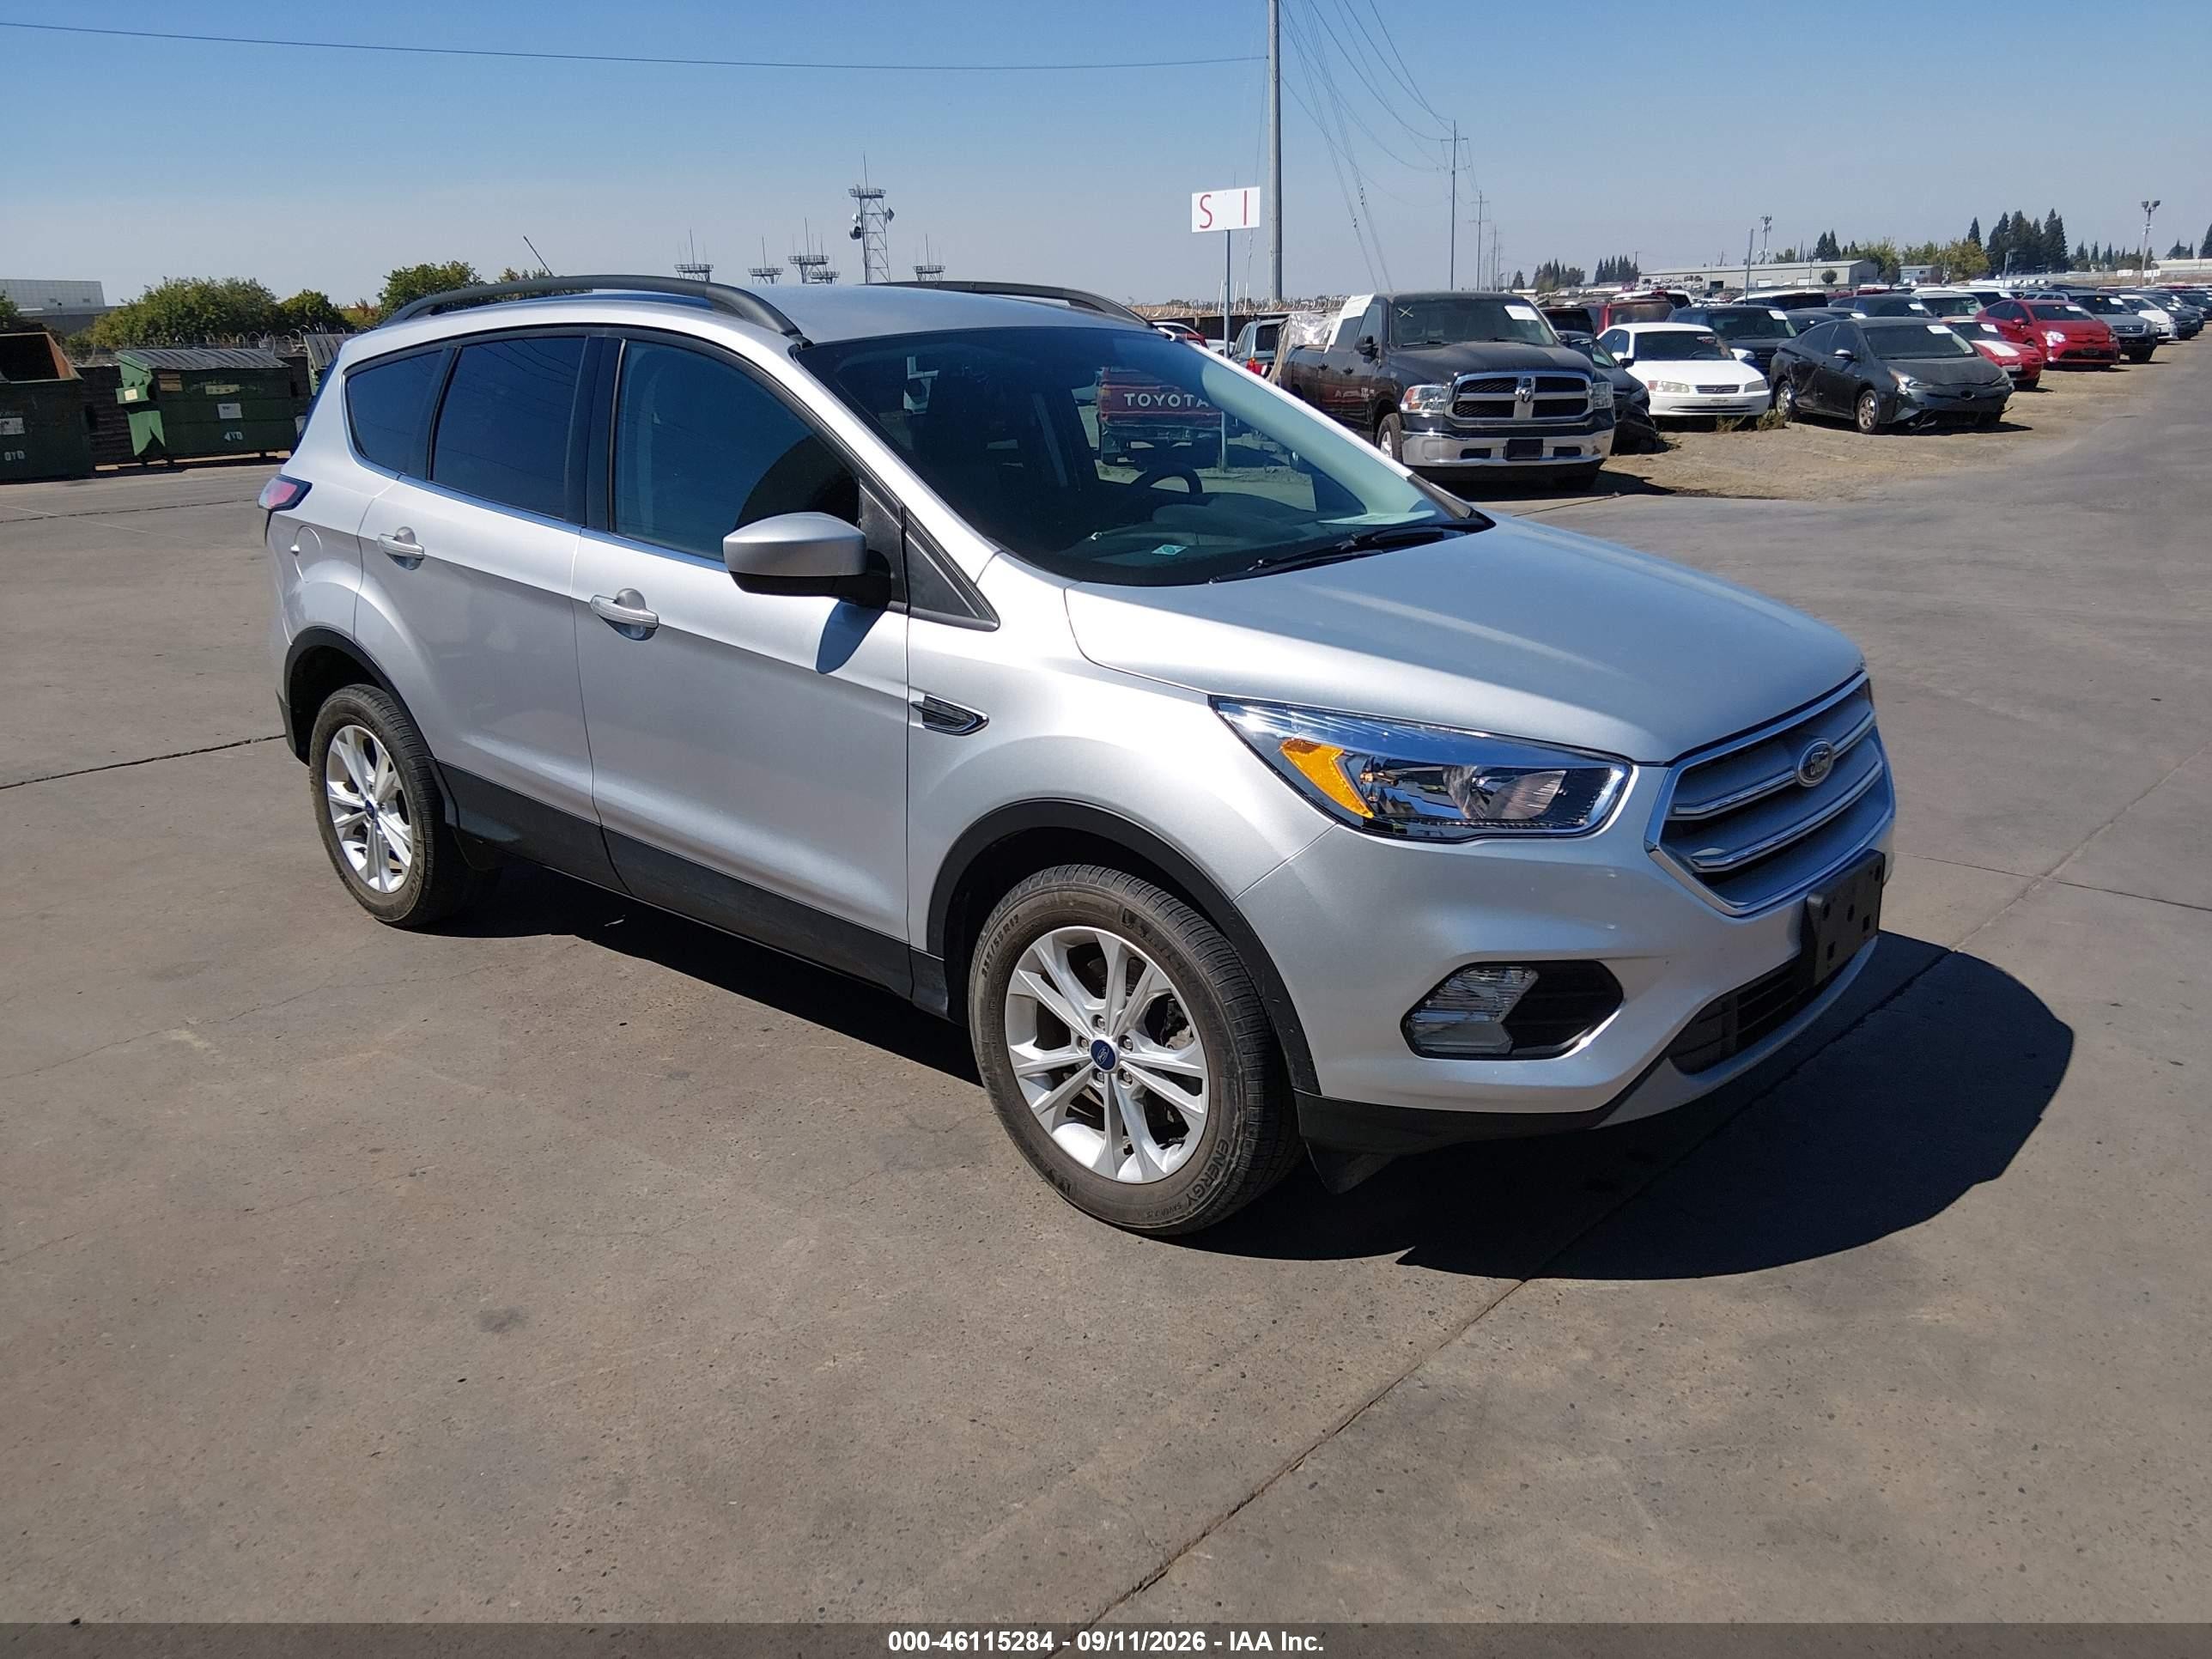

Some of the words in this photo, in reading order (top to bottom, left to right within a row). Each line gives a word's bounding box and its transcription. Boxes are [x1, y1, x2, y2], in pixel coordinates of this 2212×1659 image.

[1199, 193, 1213, 229] S
[1123, 392, 1210, 408] TOYOTA
[1185, 1138, 1230, 1207] ENERGY
